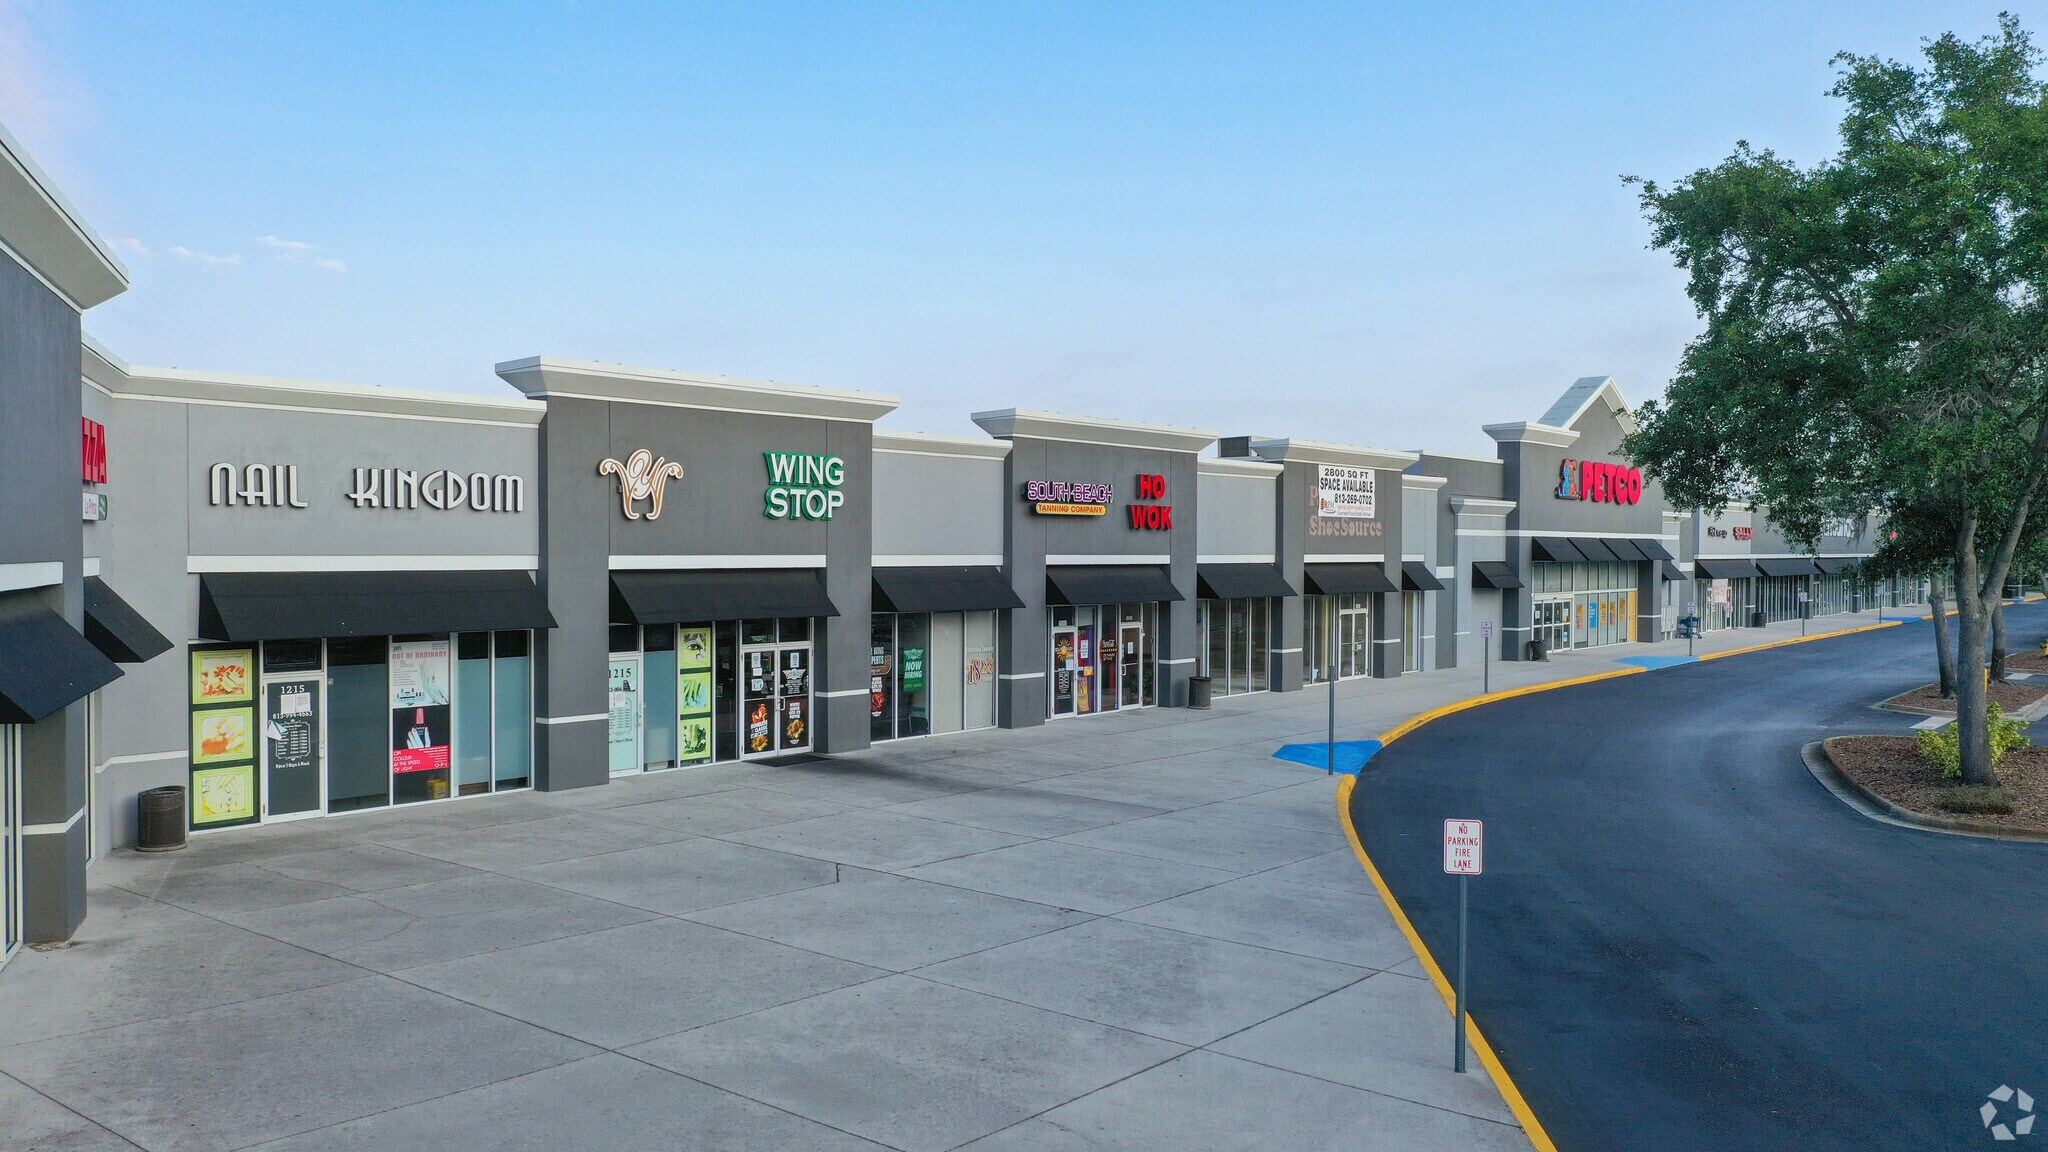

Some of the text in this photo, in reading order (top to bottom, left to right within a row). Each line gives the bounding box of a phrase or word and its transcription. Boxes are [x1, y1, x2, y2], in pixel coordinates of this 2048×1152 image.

[764, 450, 845, 487] WING
[1324, 468, 1369, 479] 2800 SQ FT
[209, 462, 524, 512] NAIL KINGDOM
[1136, 473, 1166, 499] HO
[1320, 477, 1373, 493] SPACE AVAILABLE
[1580, 460, 1642, 505] PETCO
[1027, 480, 1114, 503] SOUTH BEACH
[764, 486, 845, 520] STOP
[1038, 504, 1104, 514] TANNING COMPANY
[1127, 504, 1173, 530] WOK
[1309, 514, 1382, 536] ShoeSource
[905, 660, 922, 671] NOW
[904, 671, 922, 679] HIRING
[280, 685, 305, 694] 1215
[1458, 825, 1468, 835] NO
[1447, 836, 1479, 847] PARKING
[1455, 848, 1471, 858] FIRE
[1453, 859, 1472, 869] LANE
